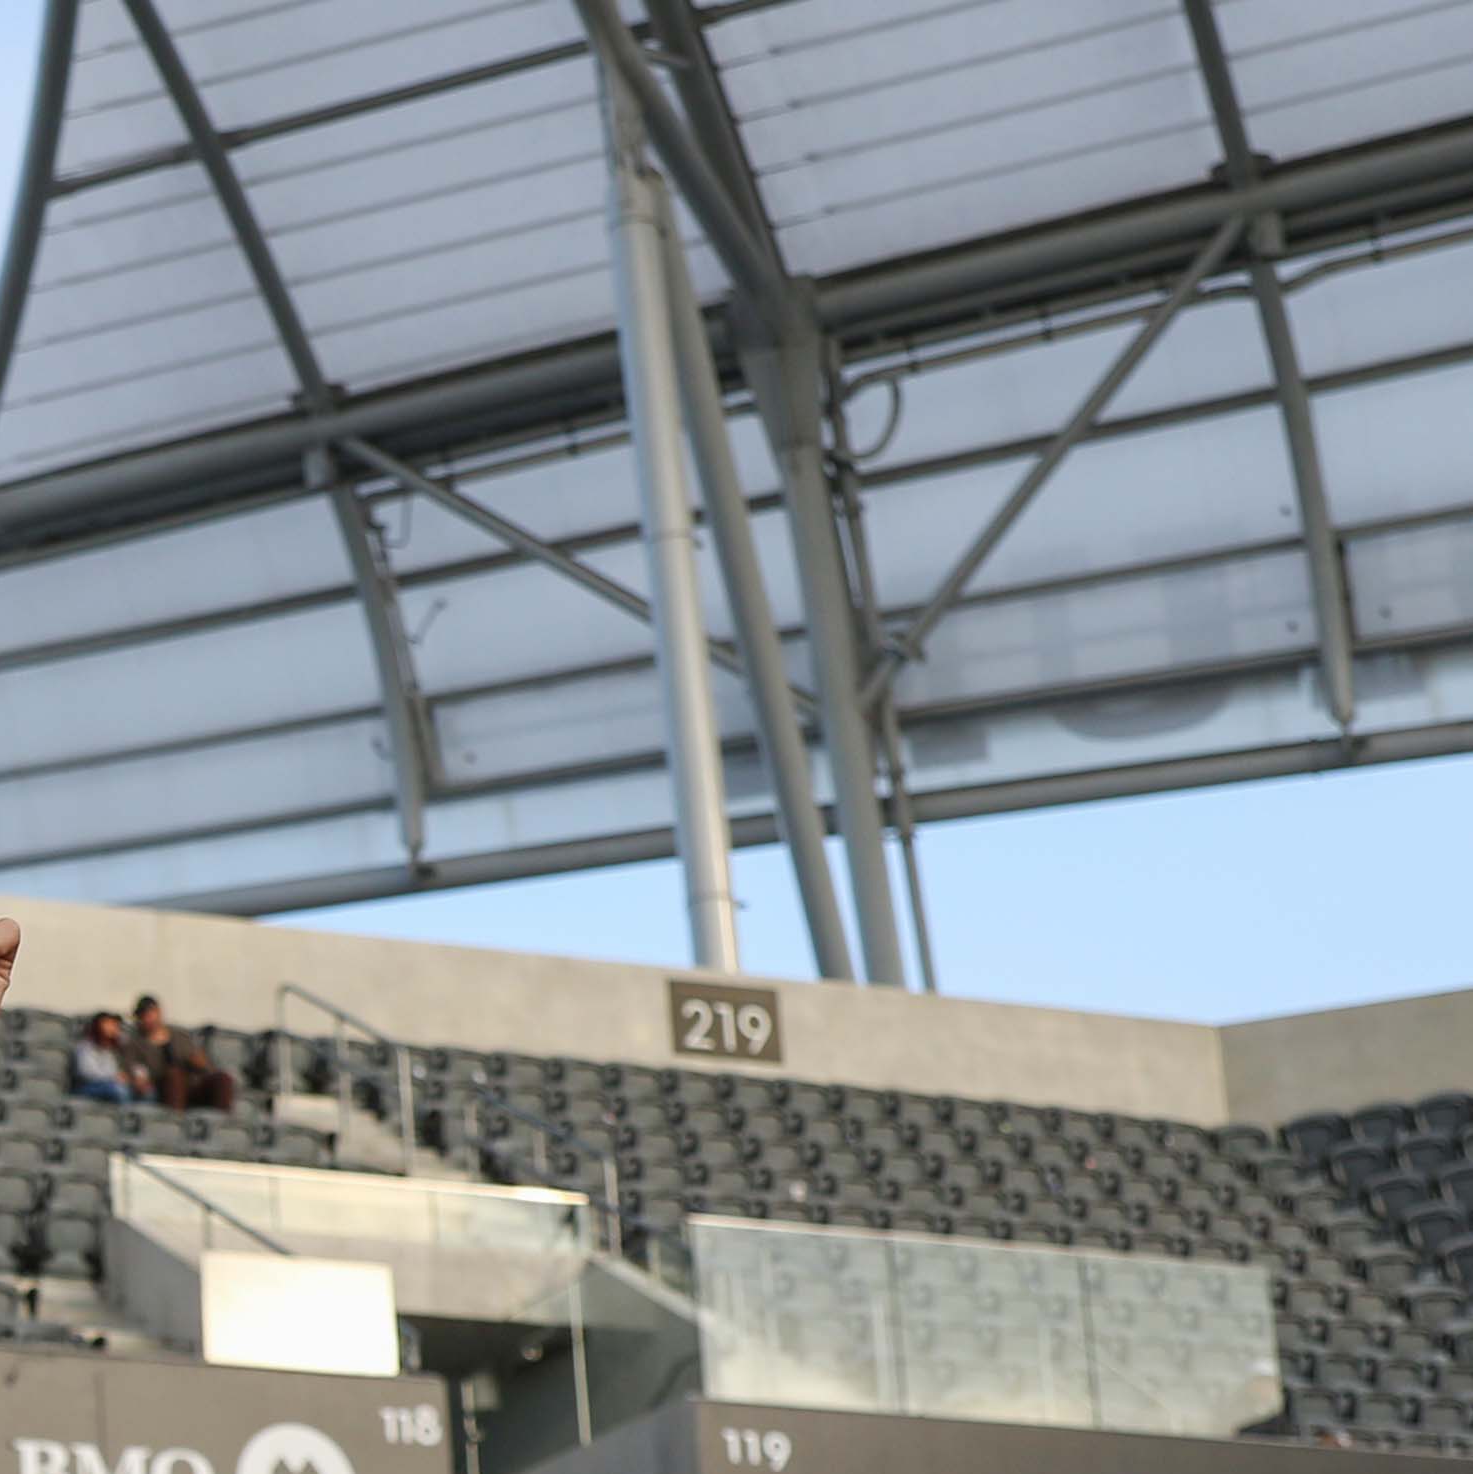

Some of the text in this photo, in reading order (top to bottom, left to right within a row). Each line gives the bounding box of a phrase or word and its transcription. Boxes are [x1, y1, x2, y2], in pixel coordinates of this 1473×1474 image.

[681, 998, 773, 1056] 219
[380, 1406, 444, 1447] 118
[721, 1427, 793, 1472] 119
